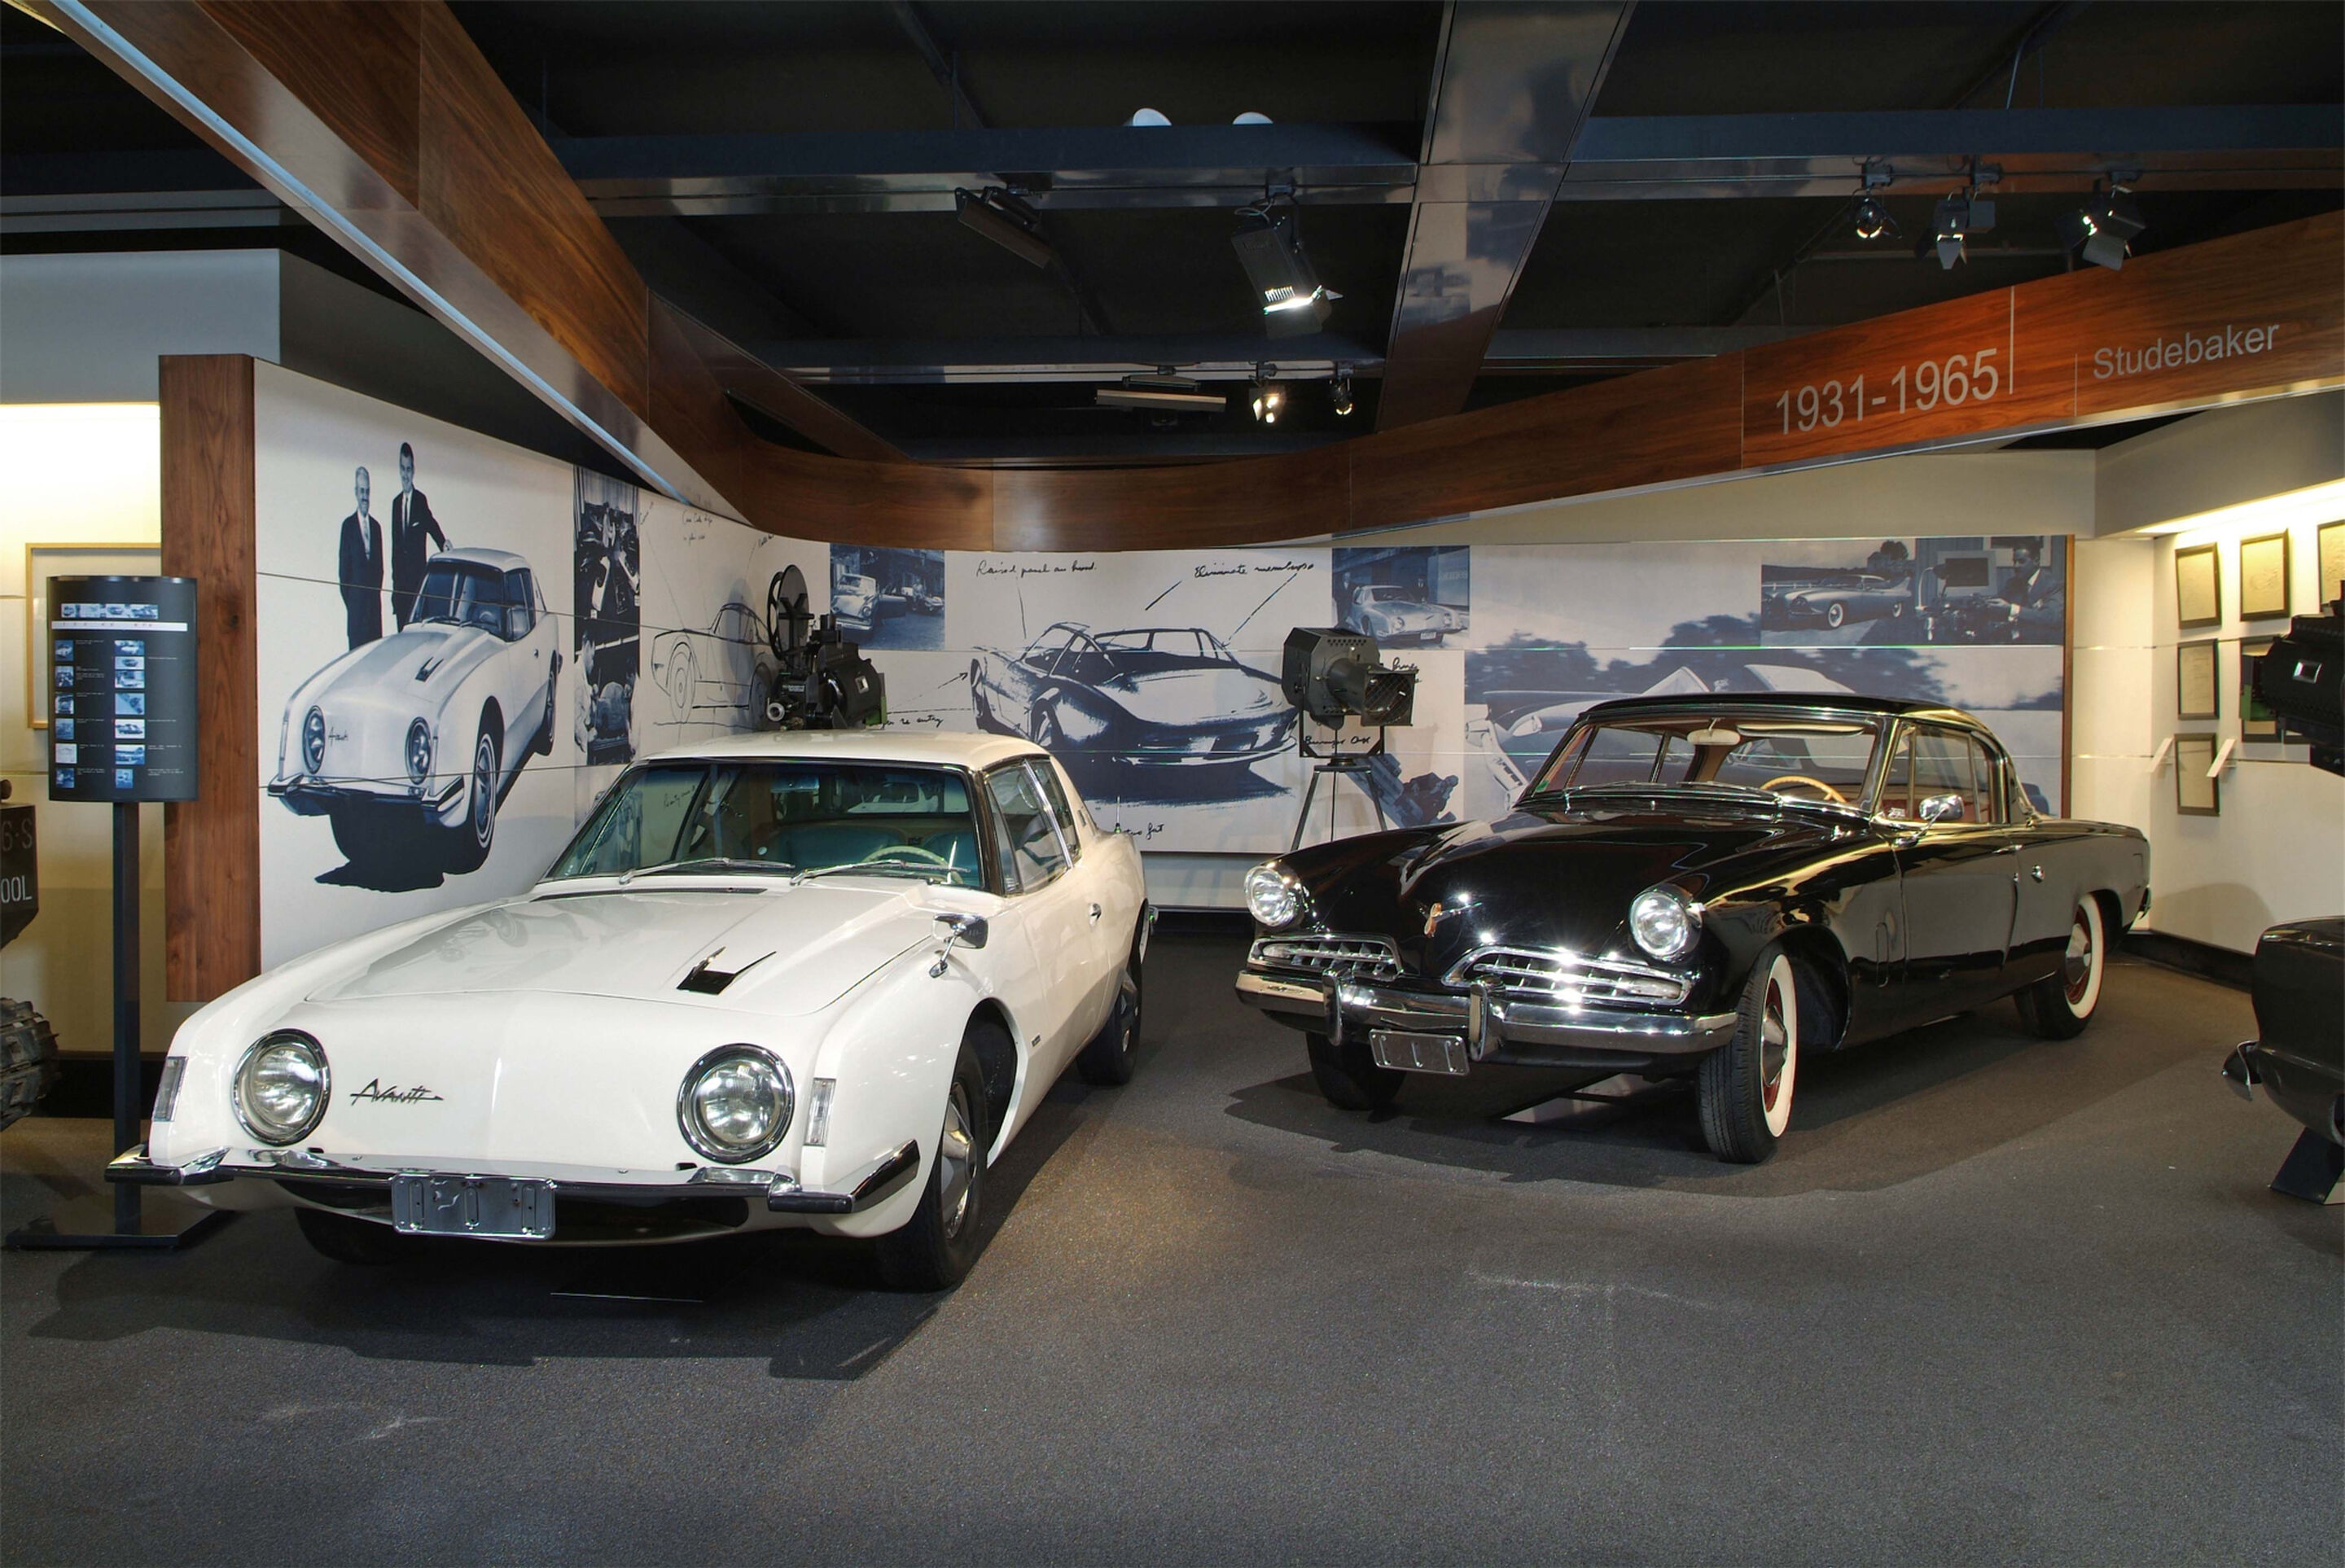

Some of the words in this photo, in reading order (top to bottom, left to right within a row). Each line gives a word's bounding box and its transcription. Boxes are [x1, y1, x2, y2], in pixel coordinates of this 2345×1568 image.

[2093, 323, 2281, 380] Studebaker
[1775, 348, 2000, 436] 1931-1965
[349, 1077, 445, 1107] Avanti
